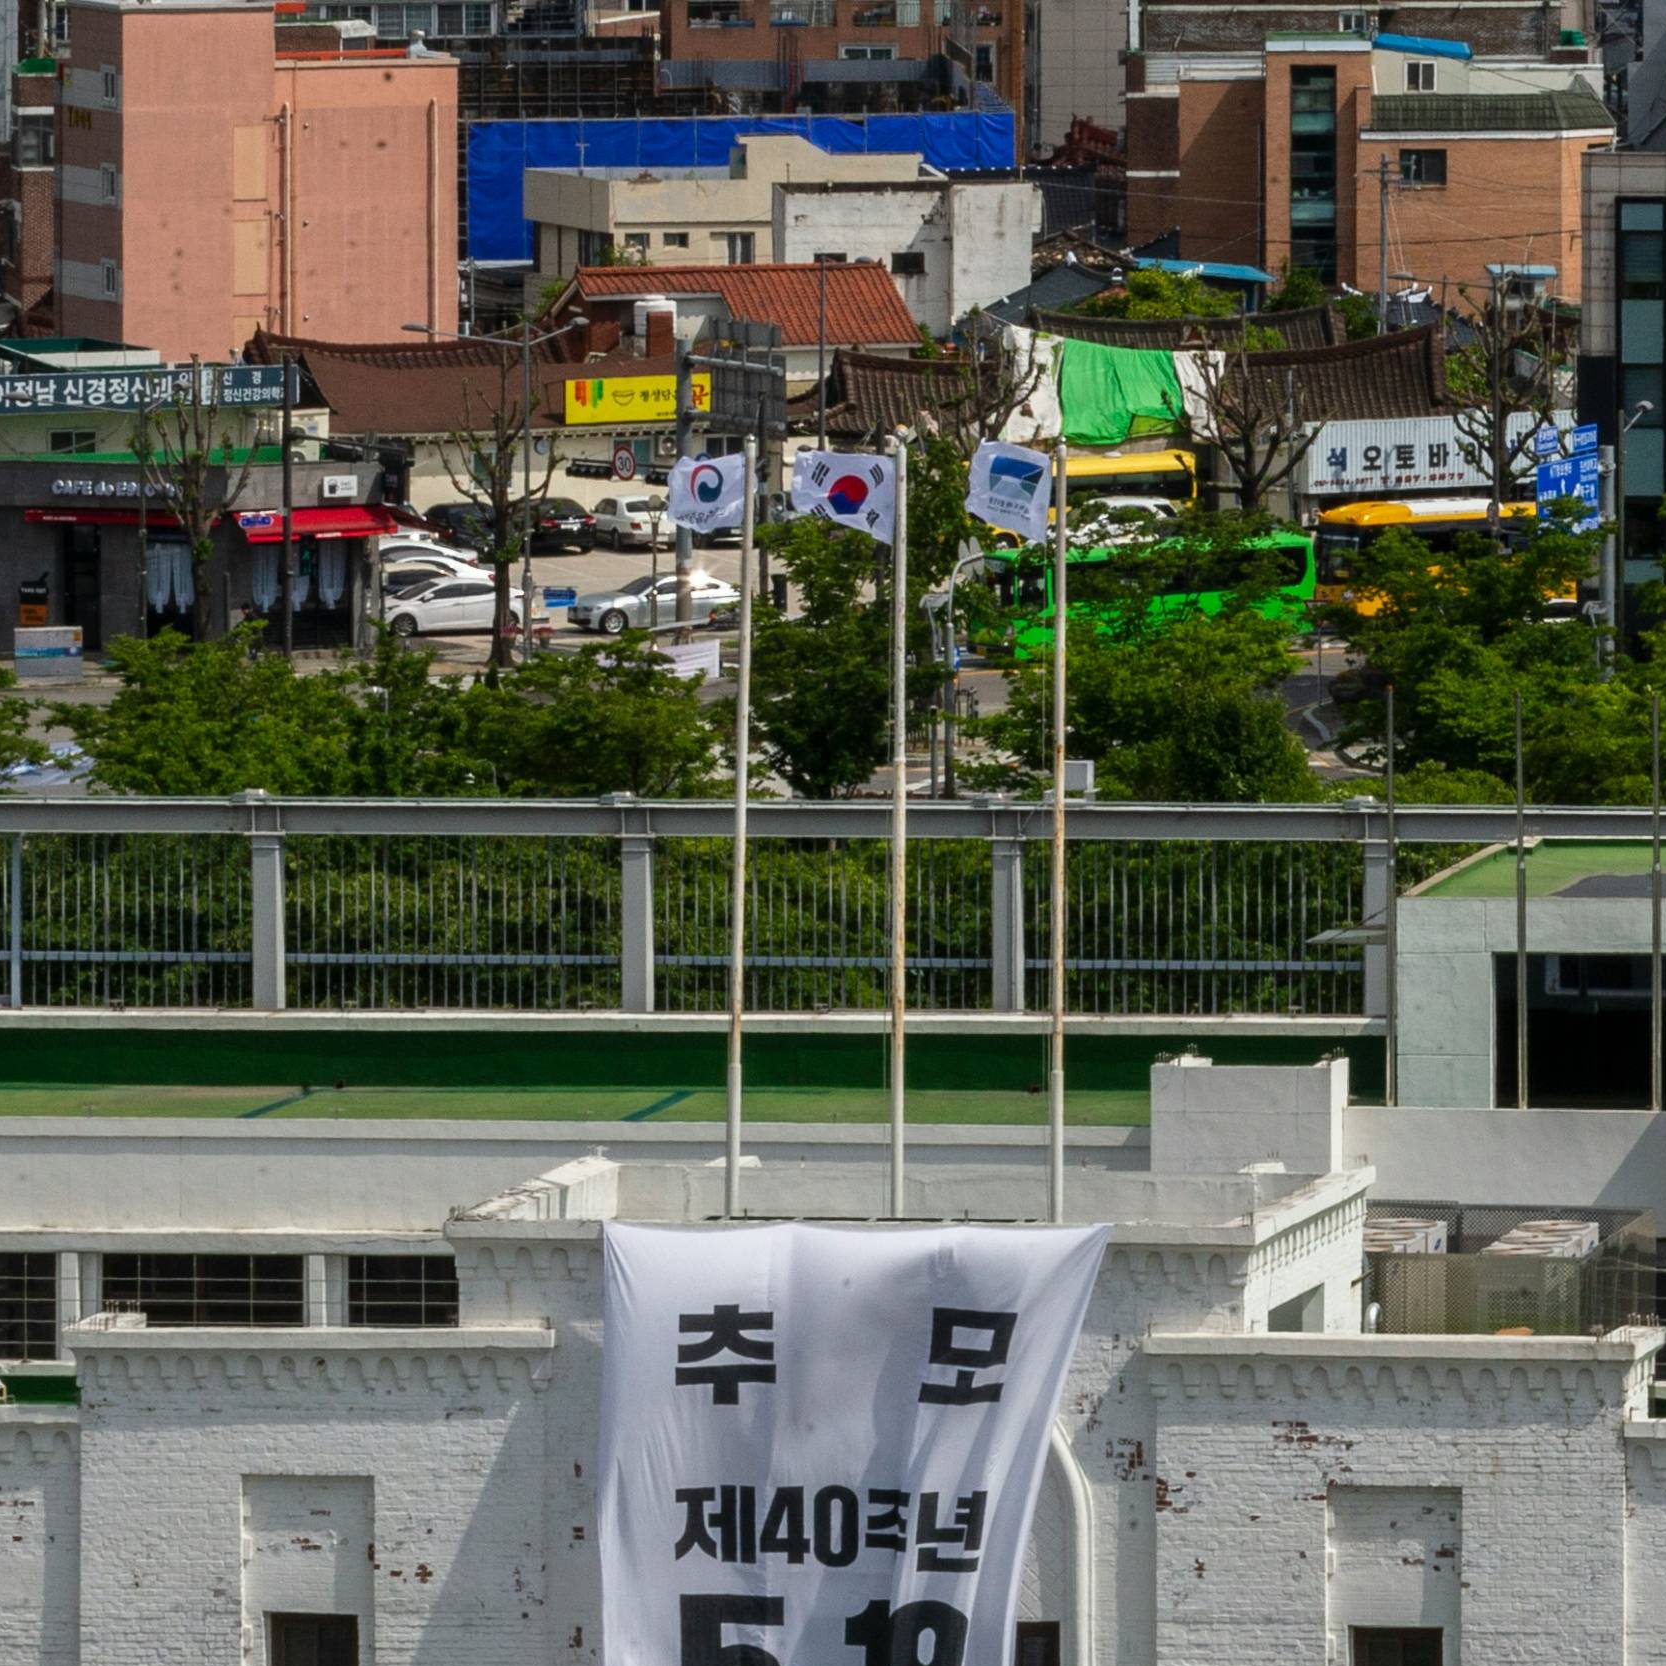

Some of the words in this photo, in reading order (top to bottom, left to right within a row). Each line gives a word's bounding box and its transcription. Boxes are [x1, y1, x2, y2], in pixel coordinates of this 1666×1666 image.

[617, 456, 631, 472] 30
[51, 479, 93, 496] CAFE
[674, 1484, 989, 1573] 제40주년
